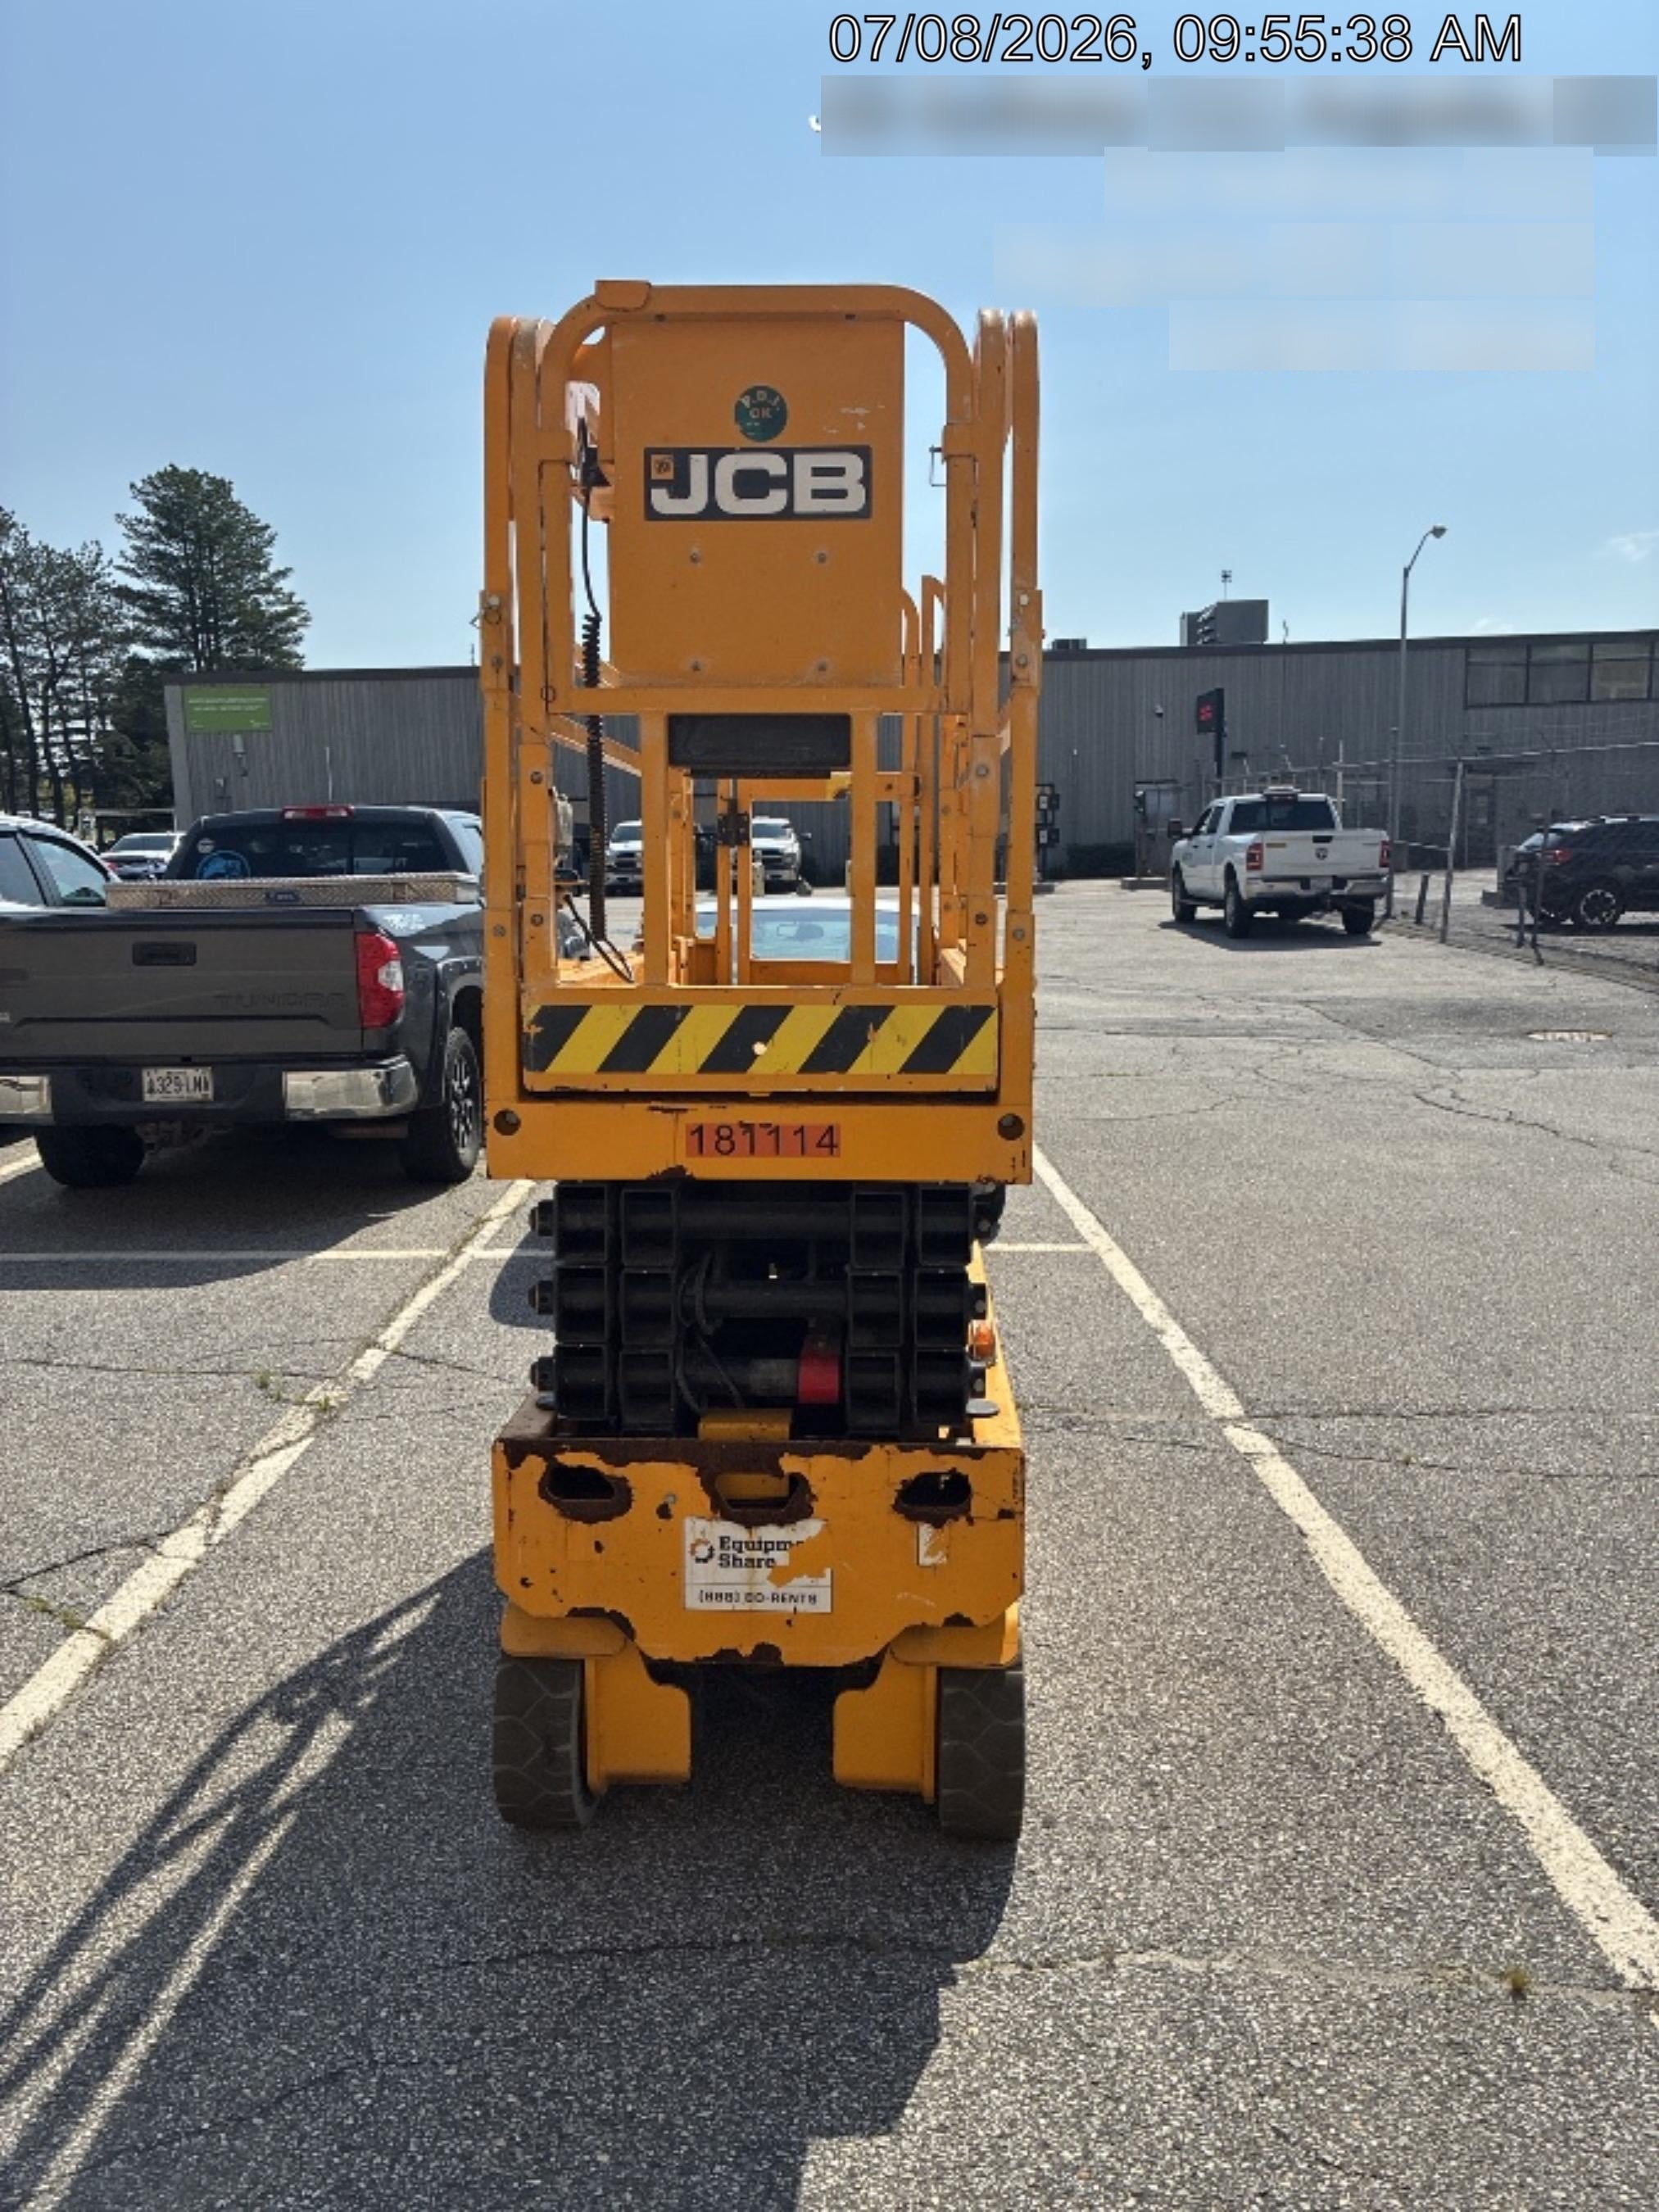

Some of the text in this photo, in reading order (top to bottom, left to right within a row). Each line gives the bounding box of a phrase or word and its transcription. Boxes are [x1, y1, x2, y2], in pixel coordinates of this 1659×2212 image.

[749, 407, 773, 419] OK
[650, 453, 867, 514] JCB
[690, 1123, 840, 1156] 181114
[718, 1552, 776, 1569] Share
